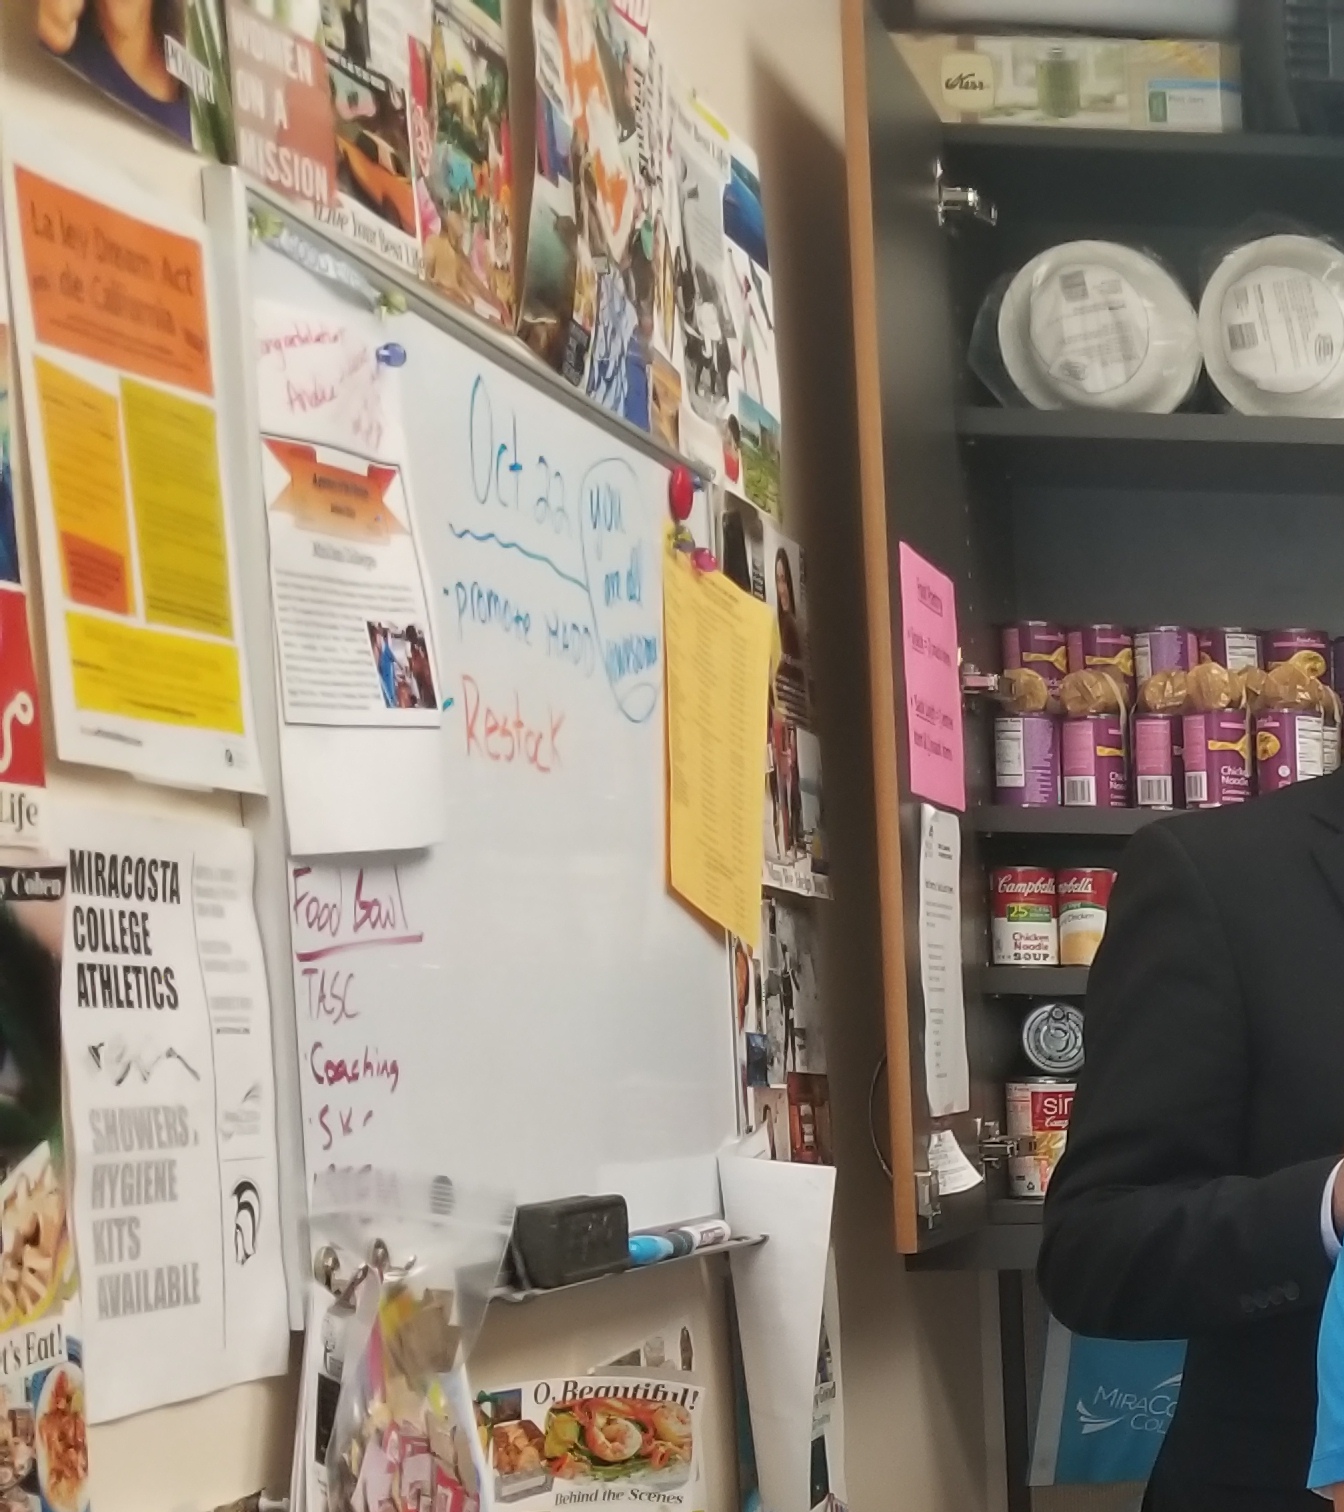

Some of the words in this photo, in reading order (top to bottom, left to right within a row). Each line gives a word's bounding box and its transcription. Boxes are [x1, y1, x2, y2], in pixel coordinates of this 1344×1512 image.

[236, 69, 266, 119] ON
[274, 88, 289, 130] A
[239, 125, 328, 206] MISSION
[161, 256, 195, 298] Act
[470, 374, 525, 511] Oct
[455, 582, 533, 646] promote
[462, 675, 566, 774] Restock
[69, 848, 181, 905] MIRACOSTA
[293, 866, 343, 937] Food
[72, 905, 153, 956] COLLEGE
[1010, 905, 1029, 918] 25
[1012, 932, 1050, 943] Chicken
[1012, 952, 1050, 962] SOUP
[1013, 941, 1049, 951] Noodle
[77, 962, 180, 1011] ATHLETICS
[309, 1040, 400, 1093] Coaching
[90, 1159, 179, 1211] HYGIENE
[91, 1215, 142, 1266] KITS
[98, 1262, 201, 1321] AVAILABLE
[25, 1323, 63, 1366] Eat!
[561, 1379, 699, 1410] Beautiful!
[555, 1489, 600, 1506] Behind
[602, 1488, 625, 1502] the
[630, 1488, 684, 1505] Scenes
